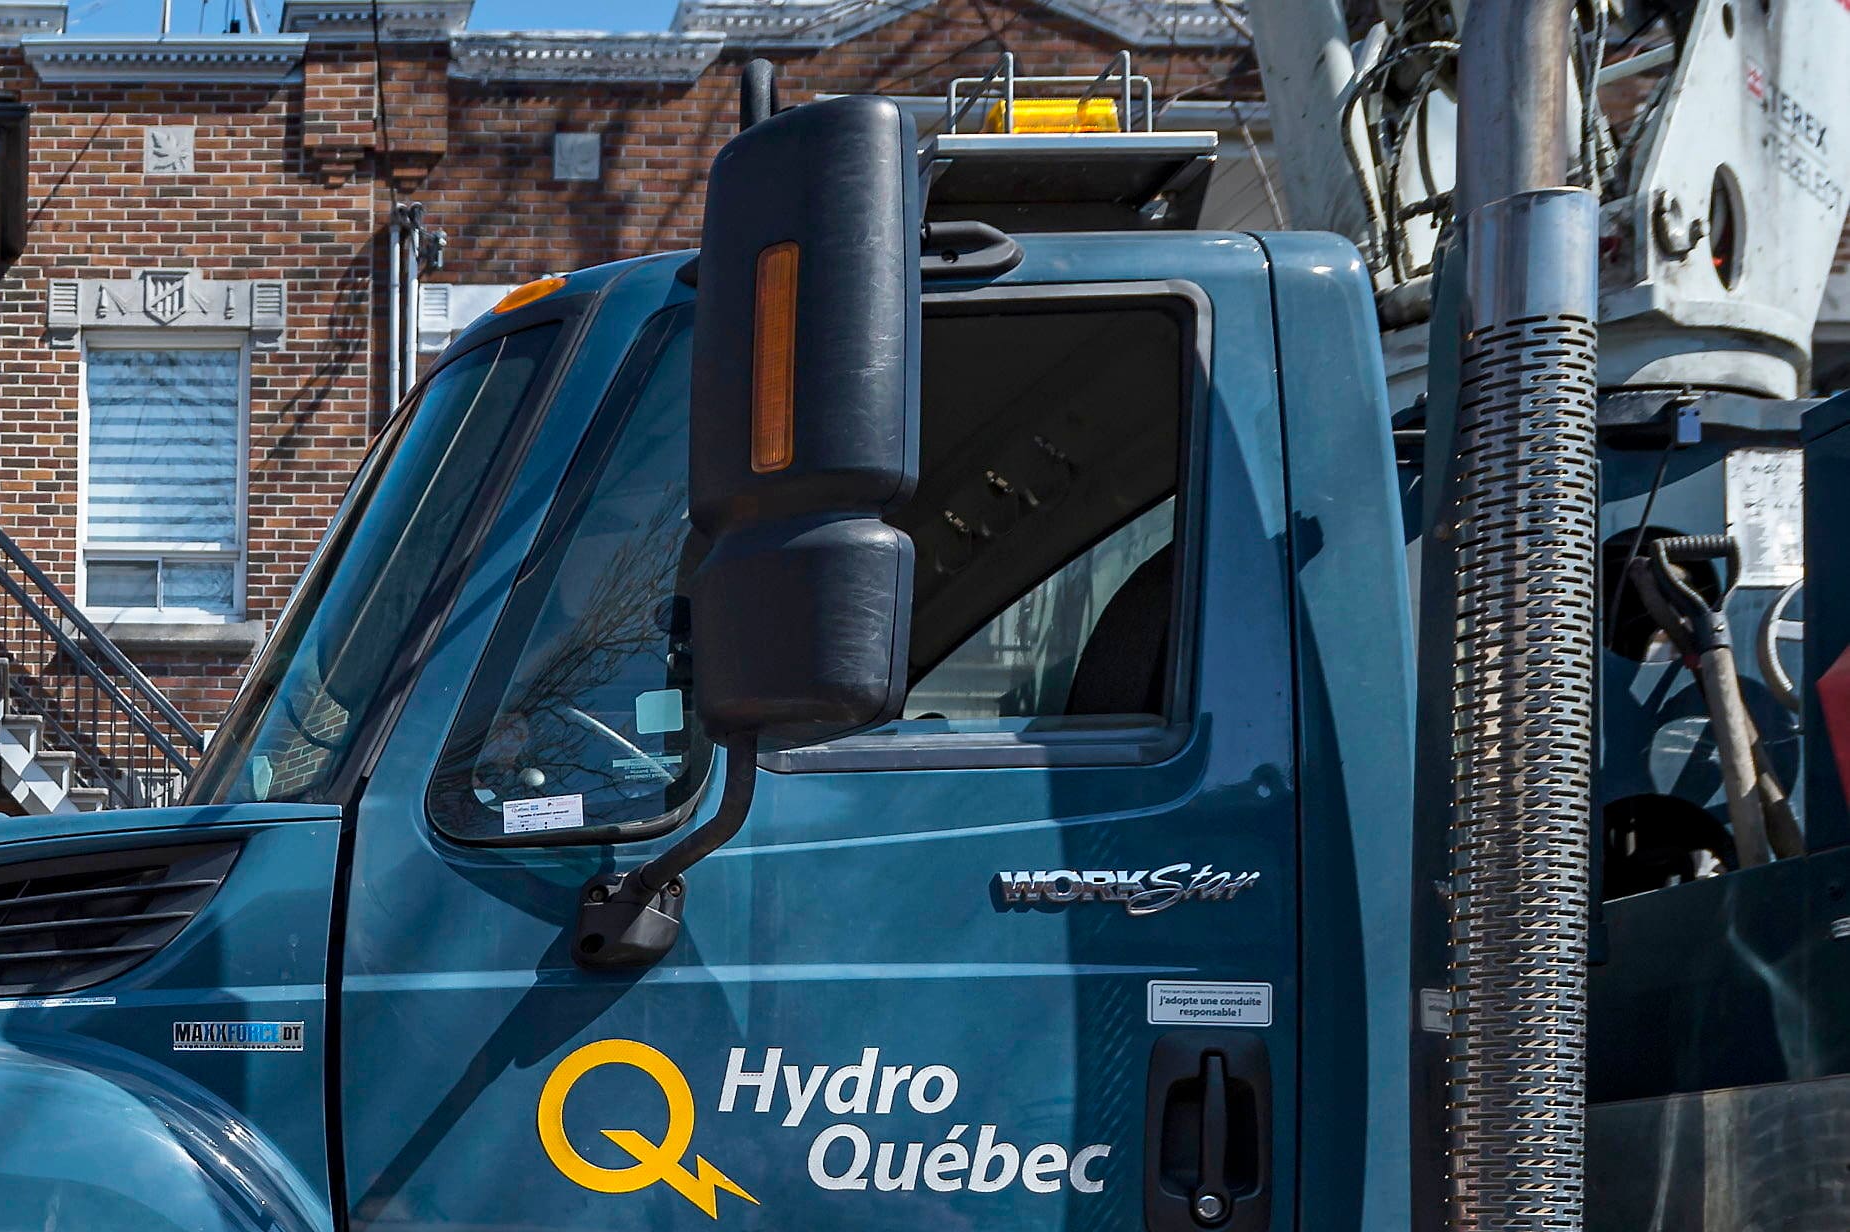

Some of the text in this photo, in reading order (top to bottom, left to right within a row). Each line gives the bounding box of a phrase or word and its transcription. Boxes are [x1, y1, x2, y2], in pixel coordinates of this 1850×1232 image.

[1200, 997, 1218, 1005] une
[1220, 996, 1262, 1006] conduite
[1179, 1007, 1237, 1017] responsable
[282, 1026, 301, 1041] DT
[718, 1046, 960, 1127] Hydro
[807, 1122, 1112, 1194] Québec
